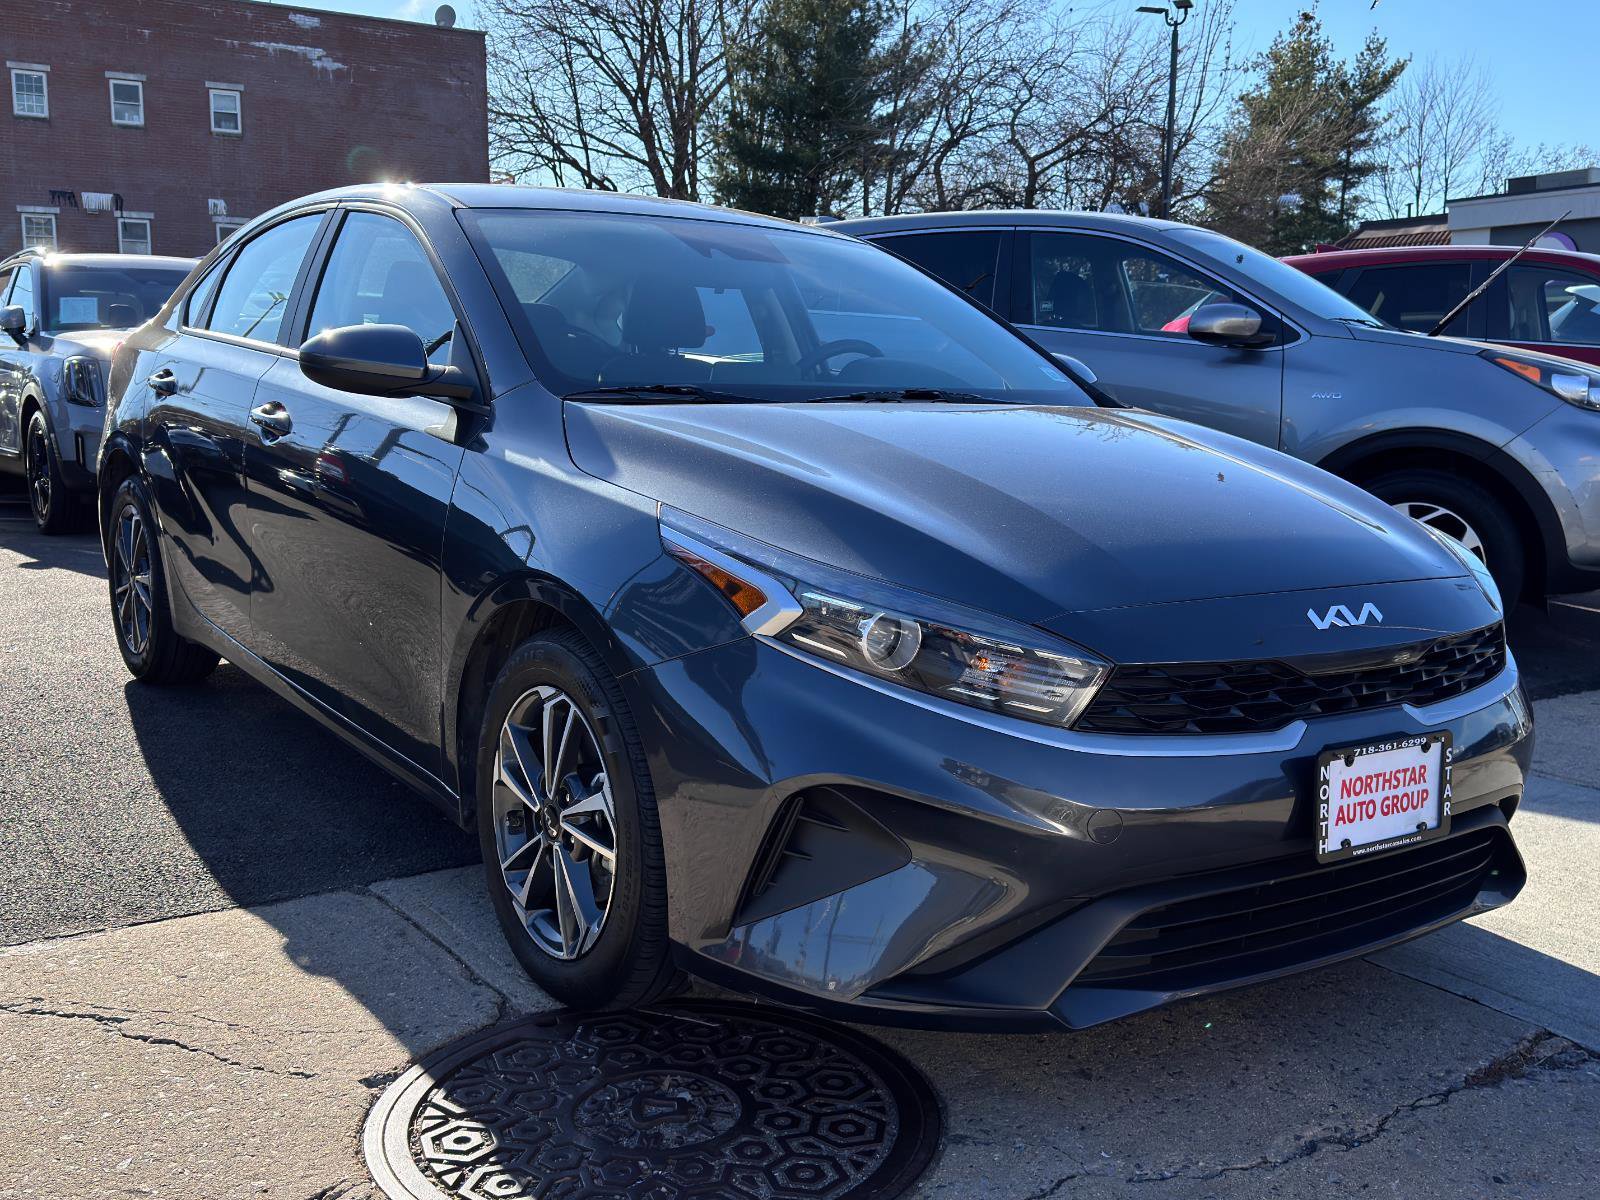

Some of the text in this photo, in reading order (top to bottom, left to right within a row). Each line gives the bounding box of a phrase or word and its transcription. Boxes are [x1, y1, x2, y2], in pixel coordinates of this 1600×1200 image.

[1311, 391, 1342, 399] AWD
[1354, 737, 1426, 756] 718-361-6299
[1340, 765, 1427, 799] NORTHSTAR
[1443, 747, 1452, 816] STAR
[1319, 766, 1329, 855] NORTH
[1335, 788, 1429, 826] AUTO GROUP
